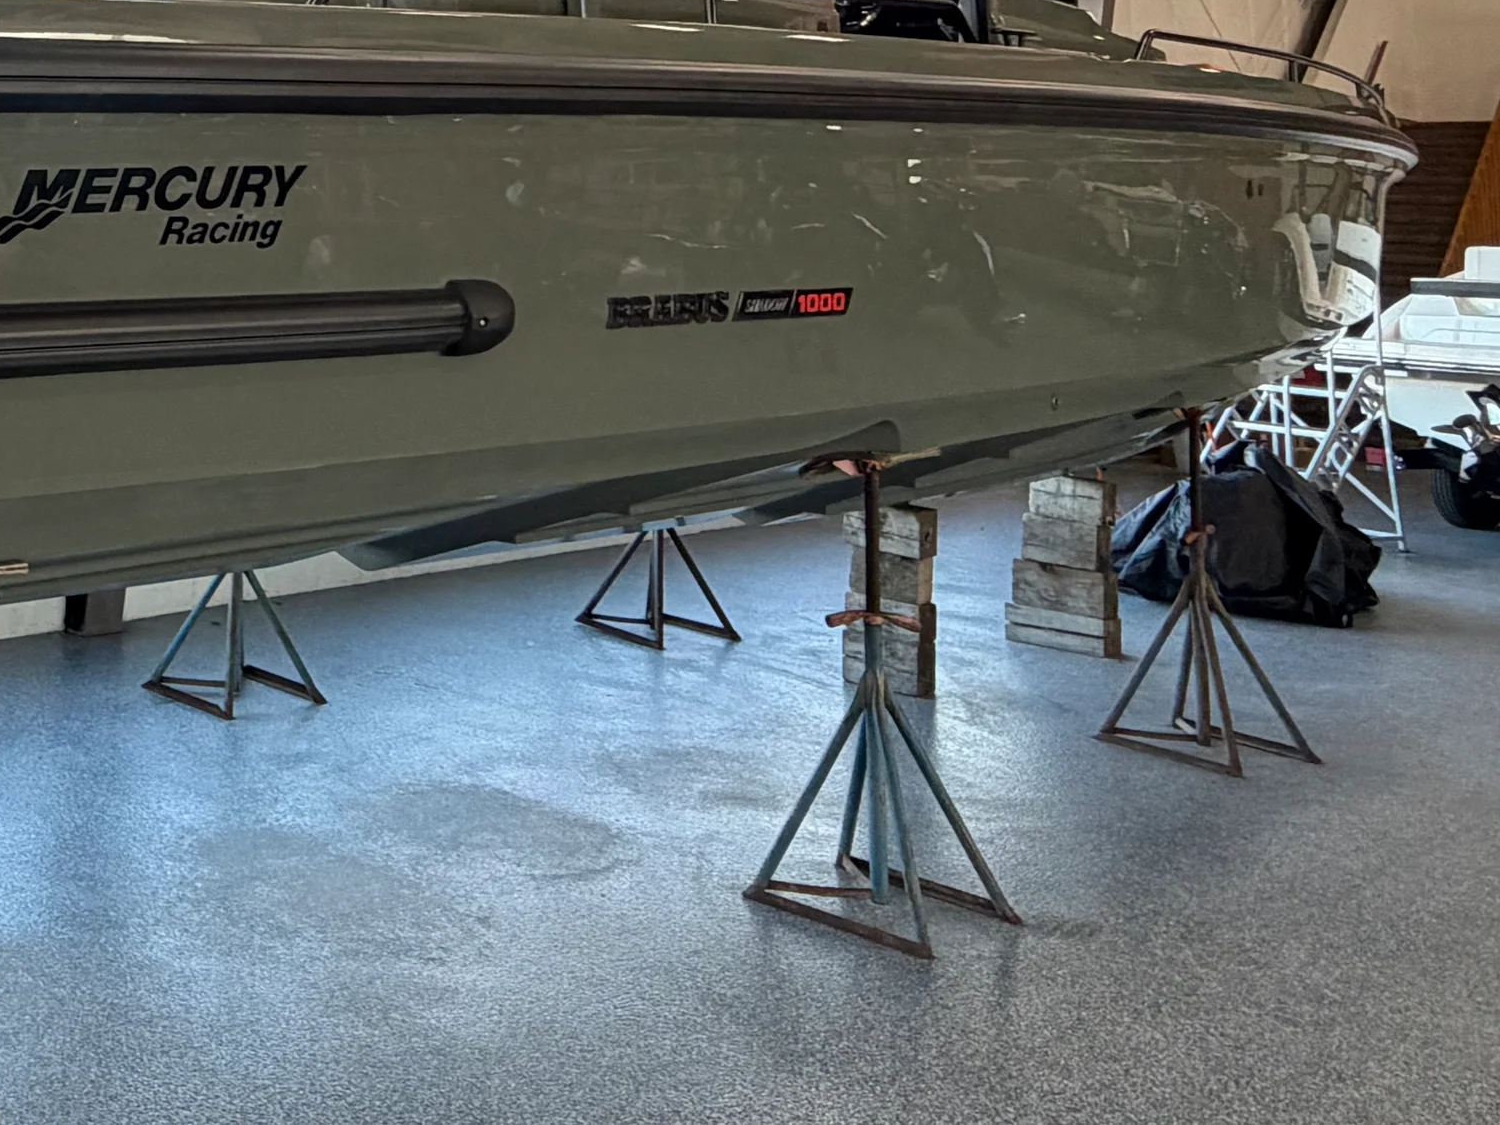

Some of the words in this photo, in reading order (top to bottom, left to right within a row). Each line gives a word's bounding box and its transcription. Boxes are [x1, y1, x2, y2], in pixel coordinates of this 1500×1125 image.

[6, 164, 309, 221] MERCURY
[159, 215, 283, 249] Racing
[605, 291, 730, 330] BRABUS
[797, 292, 846, 313] 1000
